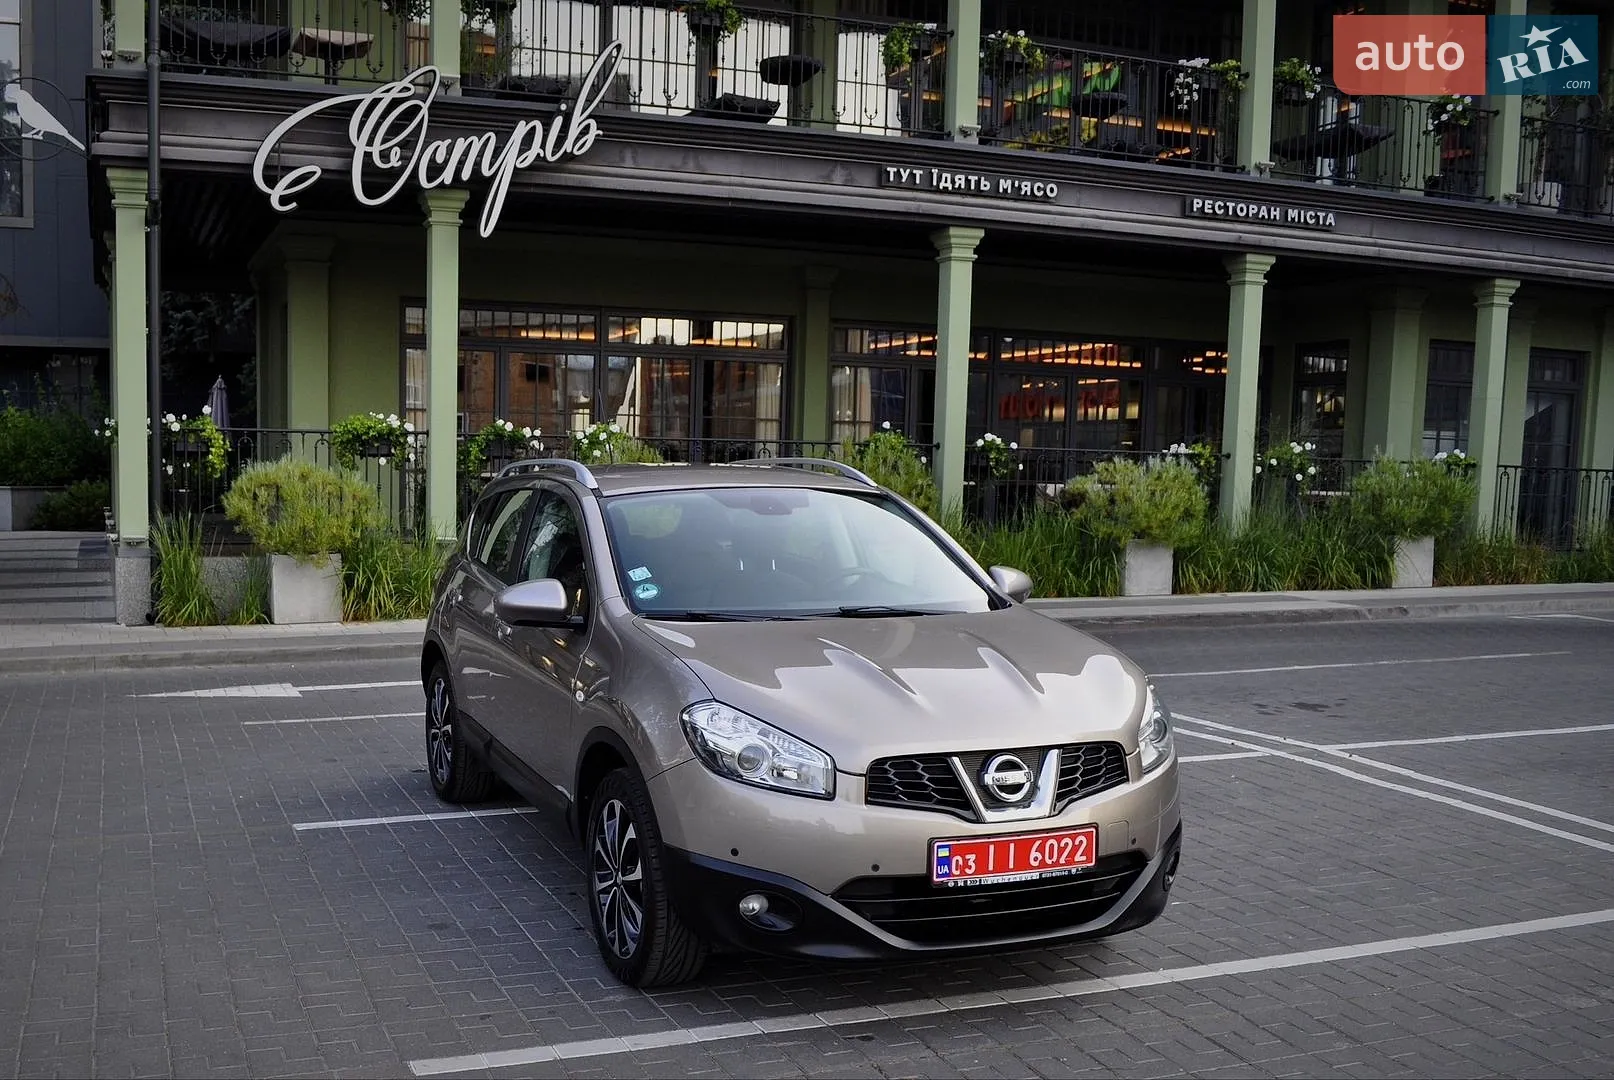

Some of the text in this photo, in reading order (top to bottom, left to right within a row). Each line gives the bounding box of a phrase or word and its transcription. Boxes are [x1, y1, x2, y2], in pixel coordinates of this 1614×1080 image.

[886, 166, 1059, 199] ТУТ ЇДЯТЬ М'ЯСО
[1192, 197, 1336, 227] РЕСТОРАН МІСТА
[937, 864, 949, 875] UA
[951, 853, 977, 876] 03
[1029, 834, 1088, 867] 6022
